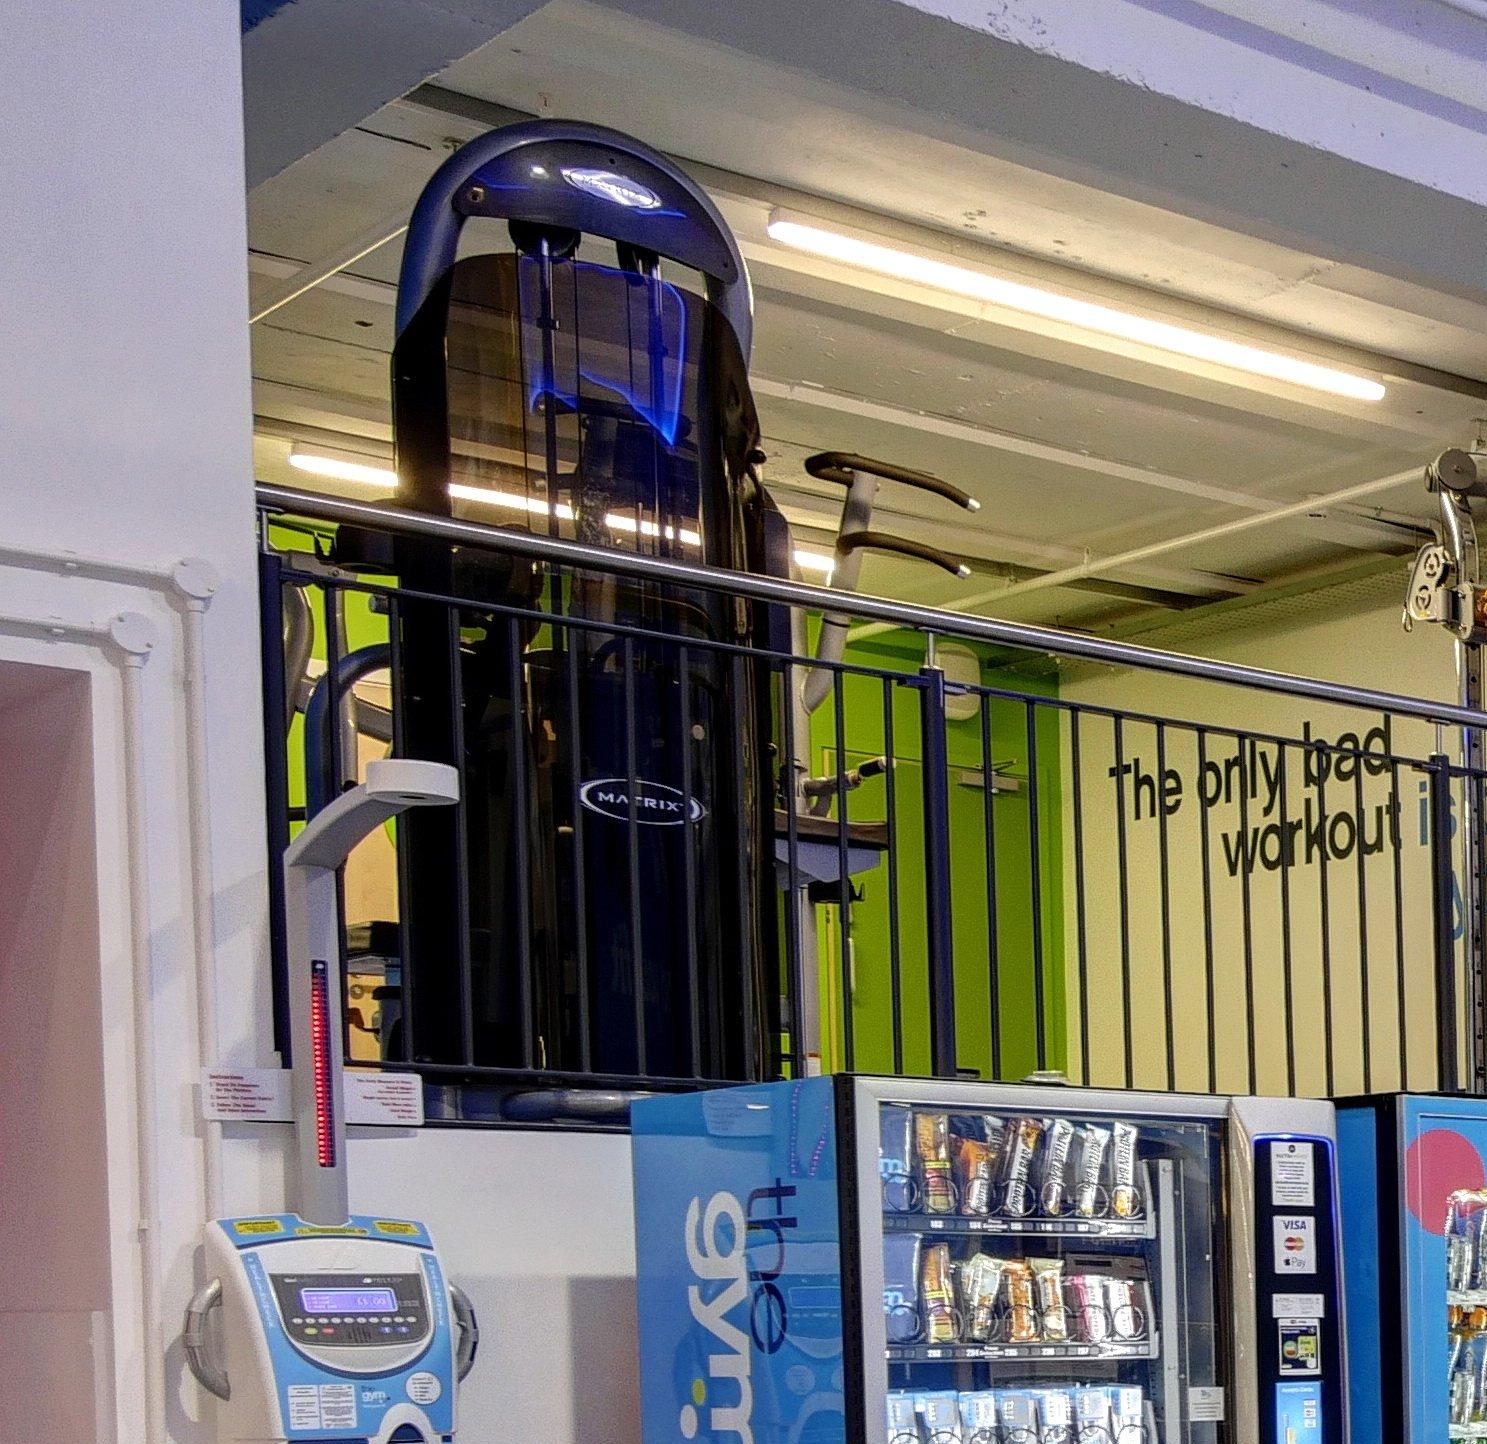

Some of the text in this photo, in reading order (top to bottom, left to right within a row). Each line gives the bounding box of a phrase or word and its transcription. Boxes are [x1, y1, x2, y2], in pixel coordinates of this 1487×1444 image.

[1303, 714, 1393, 790] bad
[1222, 790, 1401, 877] workout
[747, 1175, 798, 1355] the
[1283, 1220, 1306, 1230] VISA
